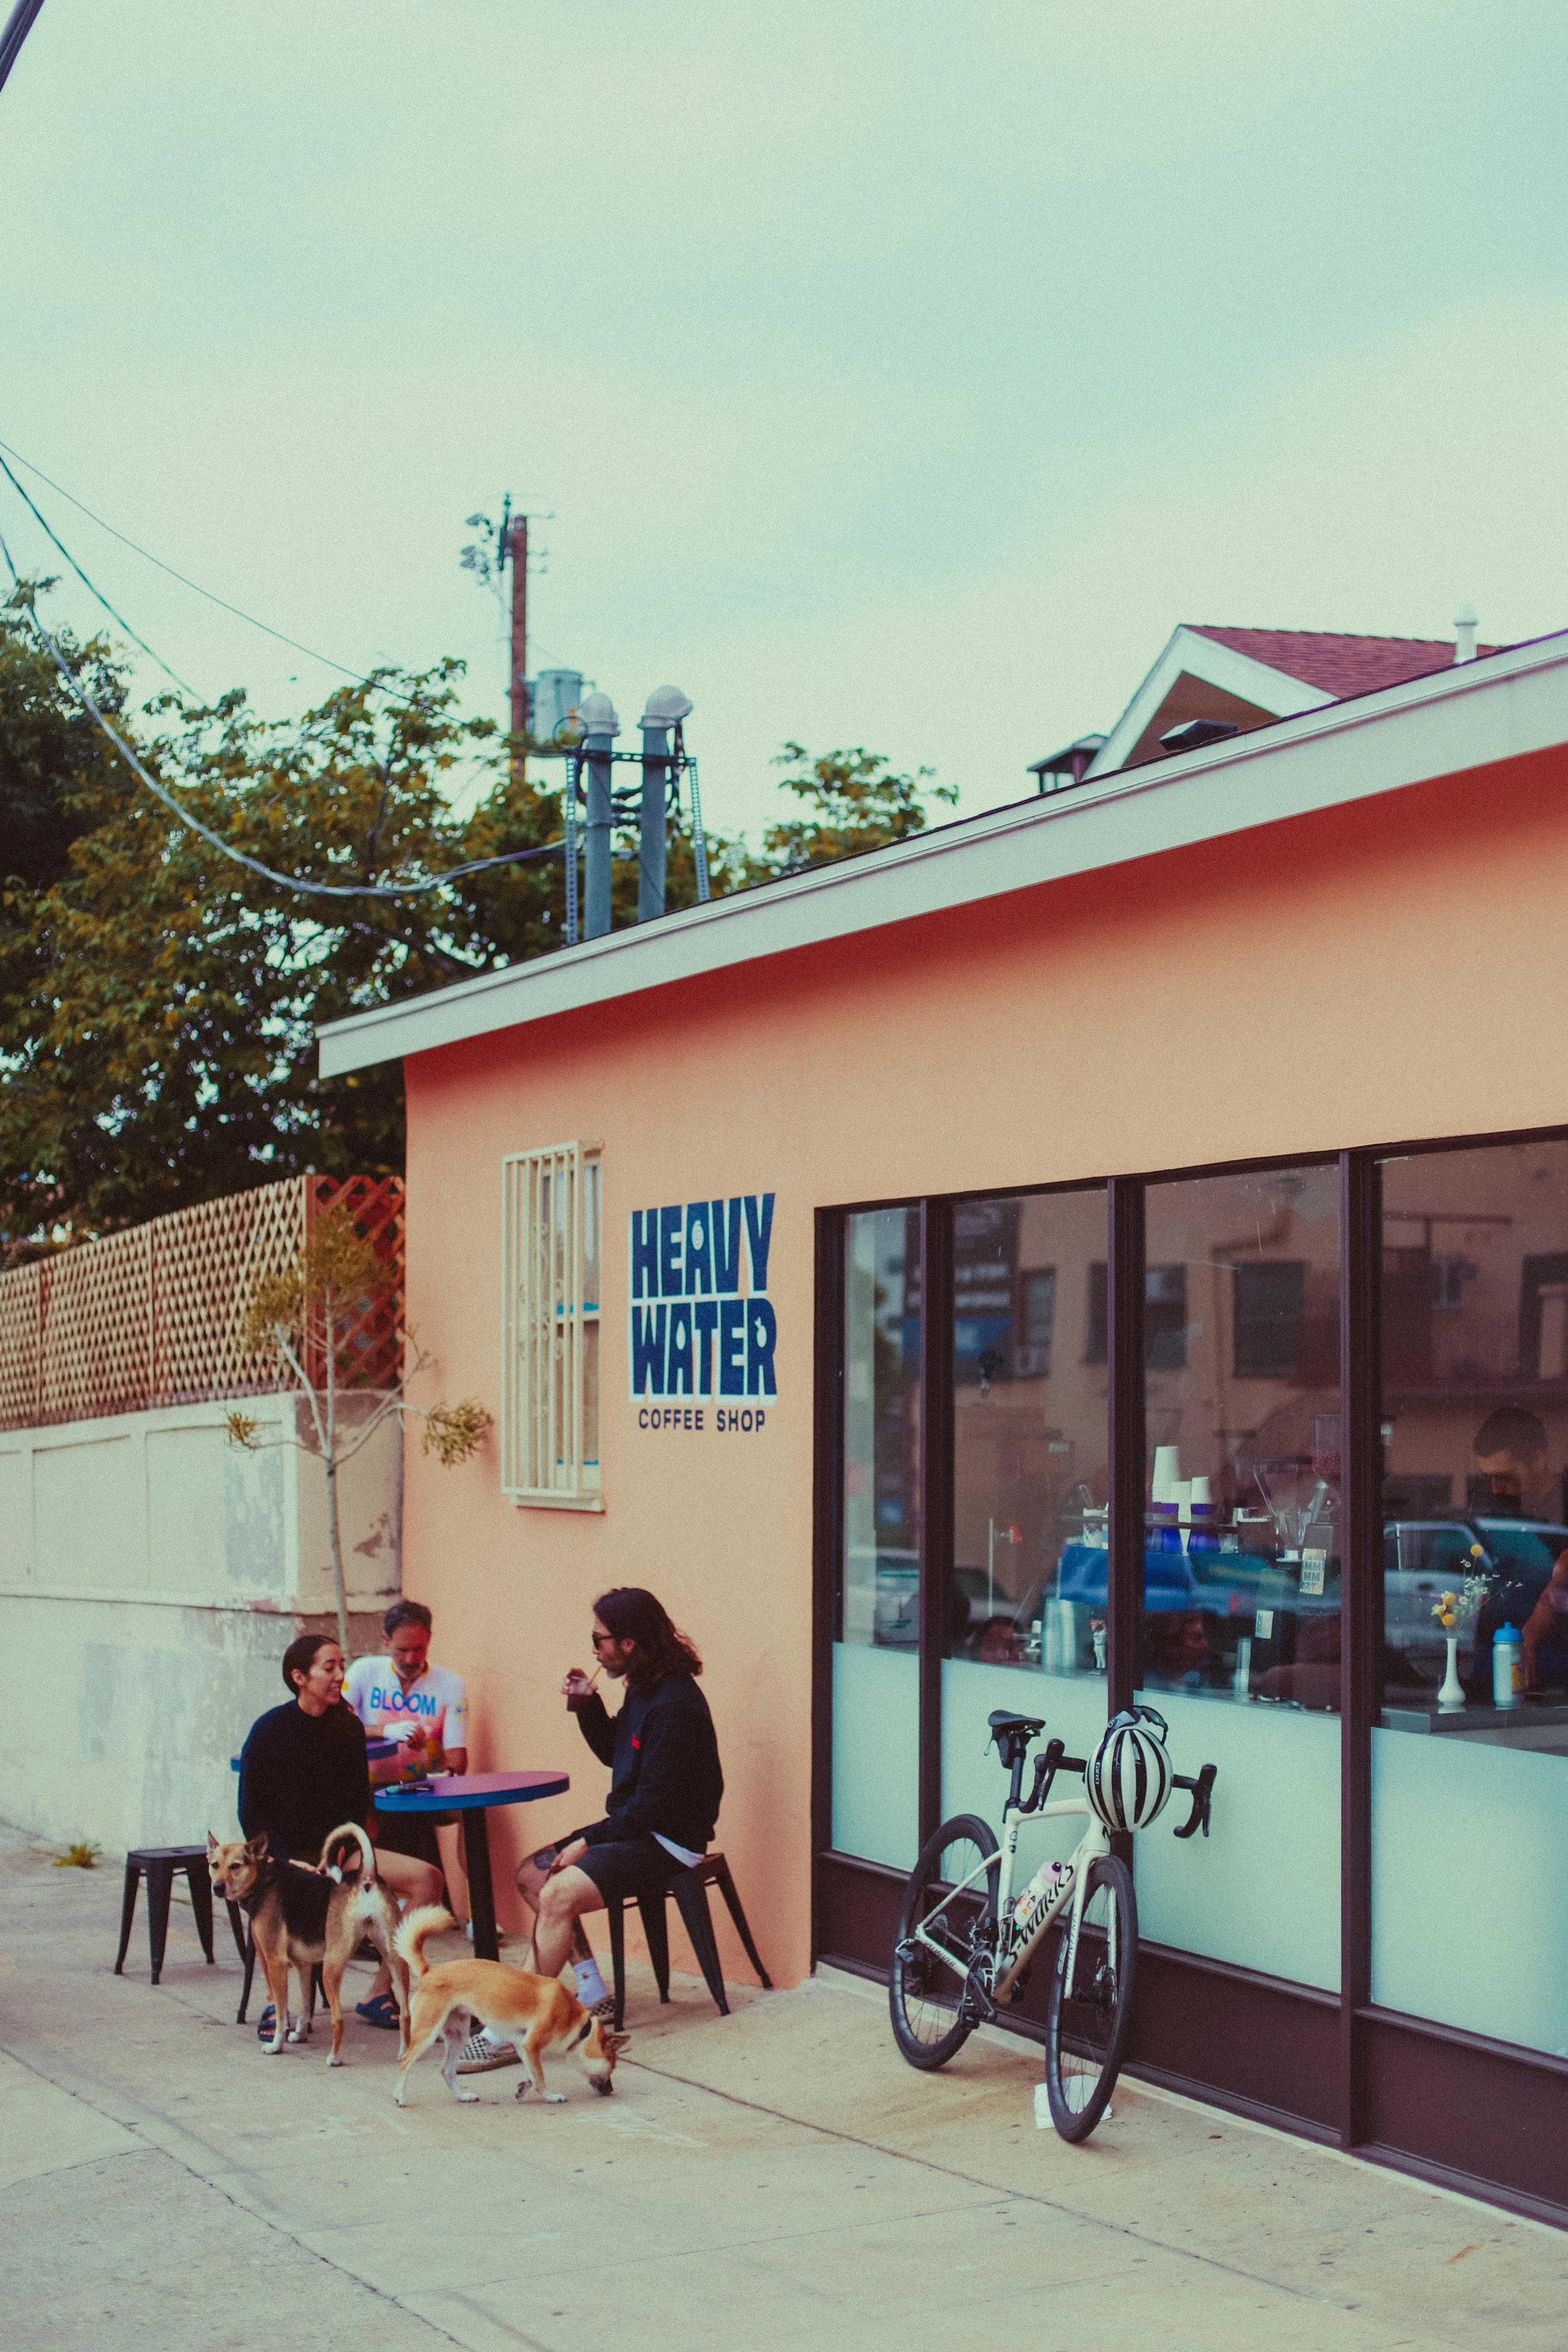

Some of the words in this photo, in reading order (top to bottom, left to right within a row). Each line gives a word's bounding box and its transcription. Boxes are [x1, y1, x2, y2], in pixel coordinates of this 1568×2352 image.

[632, 1193, 775, 1298] HEAVY
[632, 1298, 777, 1396] WATER
[638, 1409, 704, 1430] COFFEE
[717, 1410, 766, 1432] SHOP
[370, 1687, 436, 1716] BLOOM
[1009, 1865, 1074, 1968] S-WORKS
